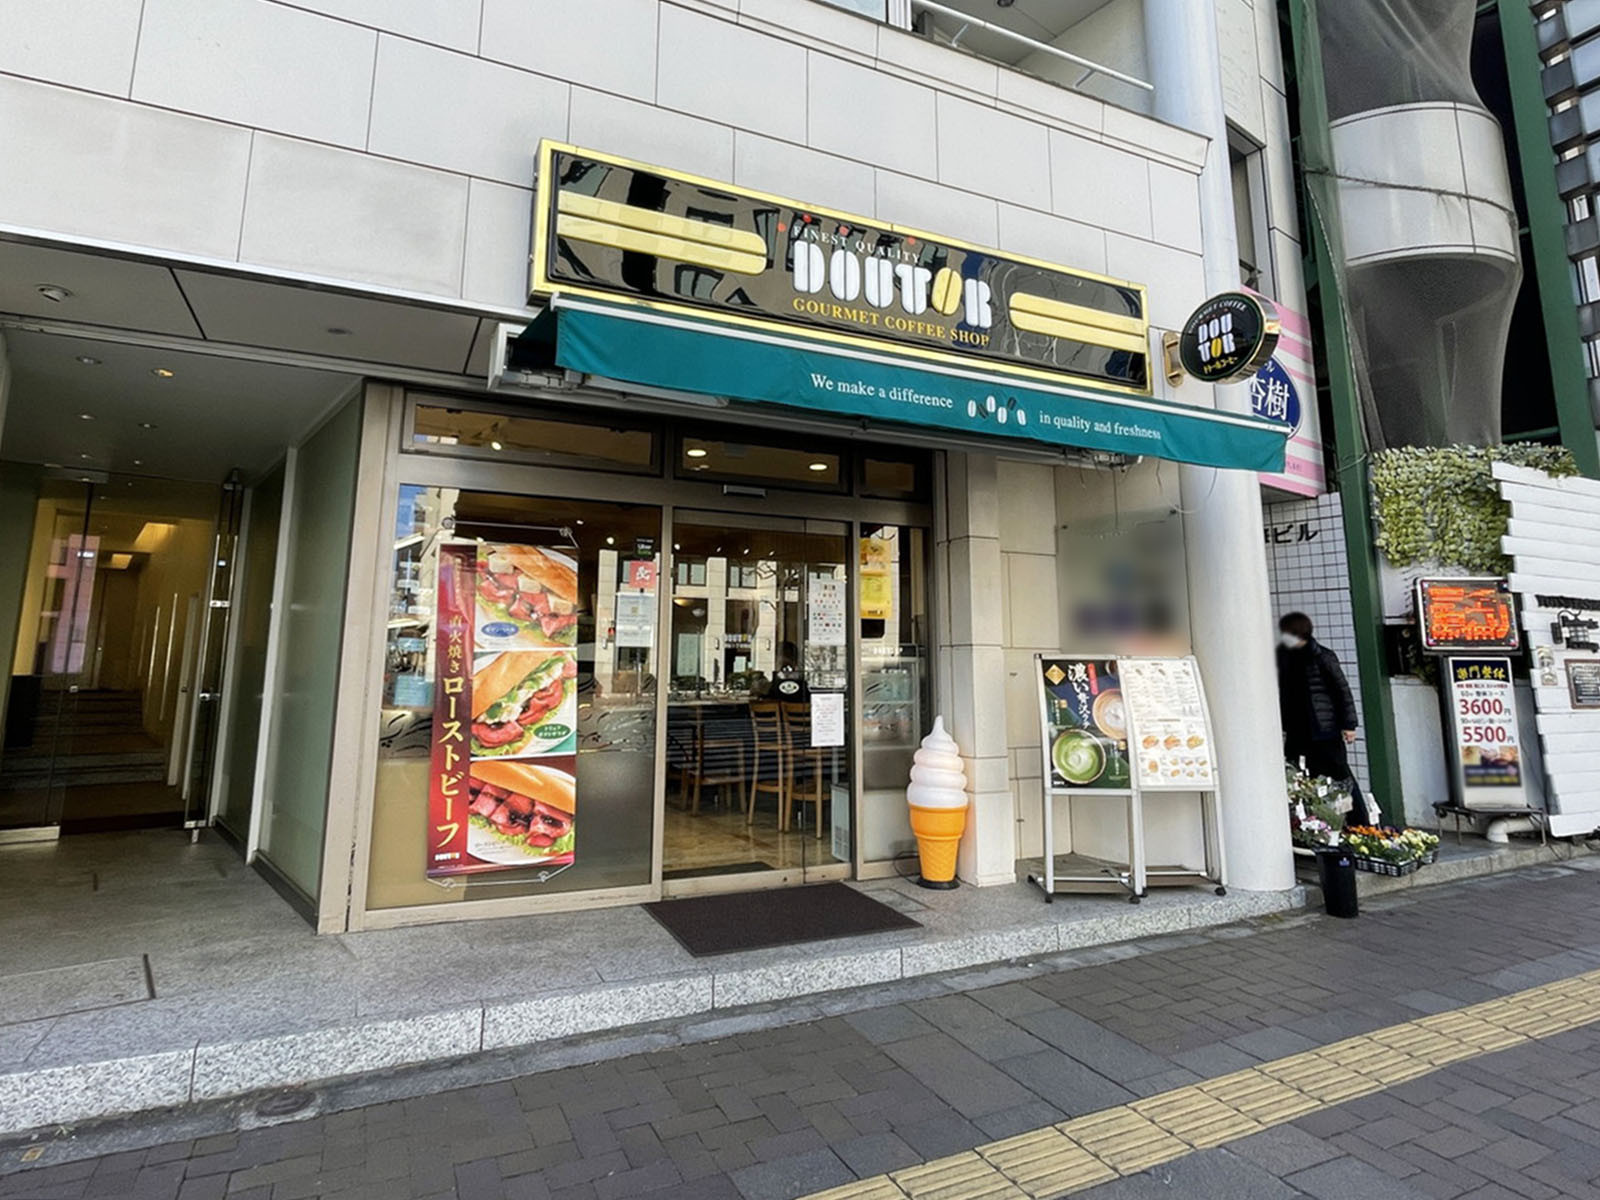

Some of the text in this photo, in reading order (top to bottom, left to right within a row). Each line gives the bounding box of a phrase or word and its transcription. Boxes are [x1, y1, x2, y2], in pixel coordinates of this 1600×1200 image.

[793, 225, 920, 262] FINEST QUALITY
[793, 239, 993, 330] DOUTOR
[793, 297, 991, 347] GOURMET COFFEE SHOP
[811, 373, 953, 409] We make a difference
[1039, 410, 1161, 440] in quality and freshness
